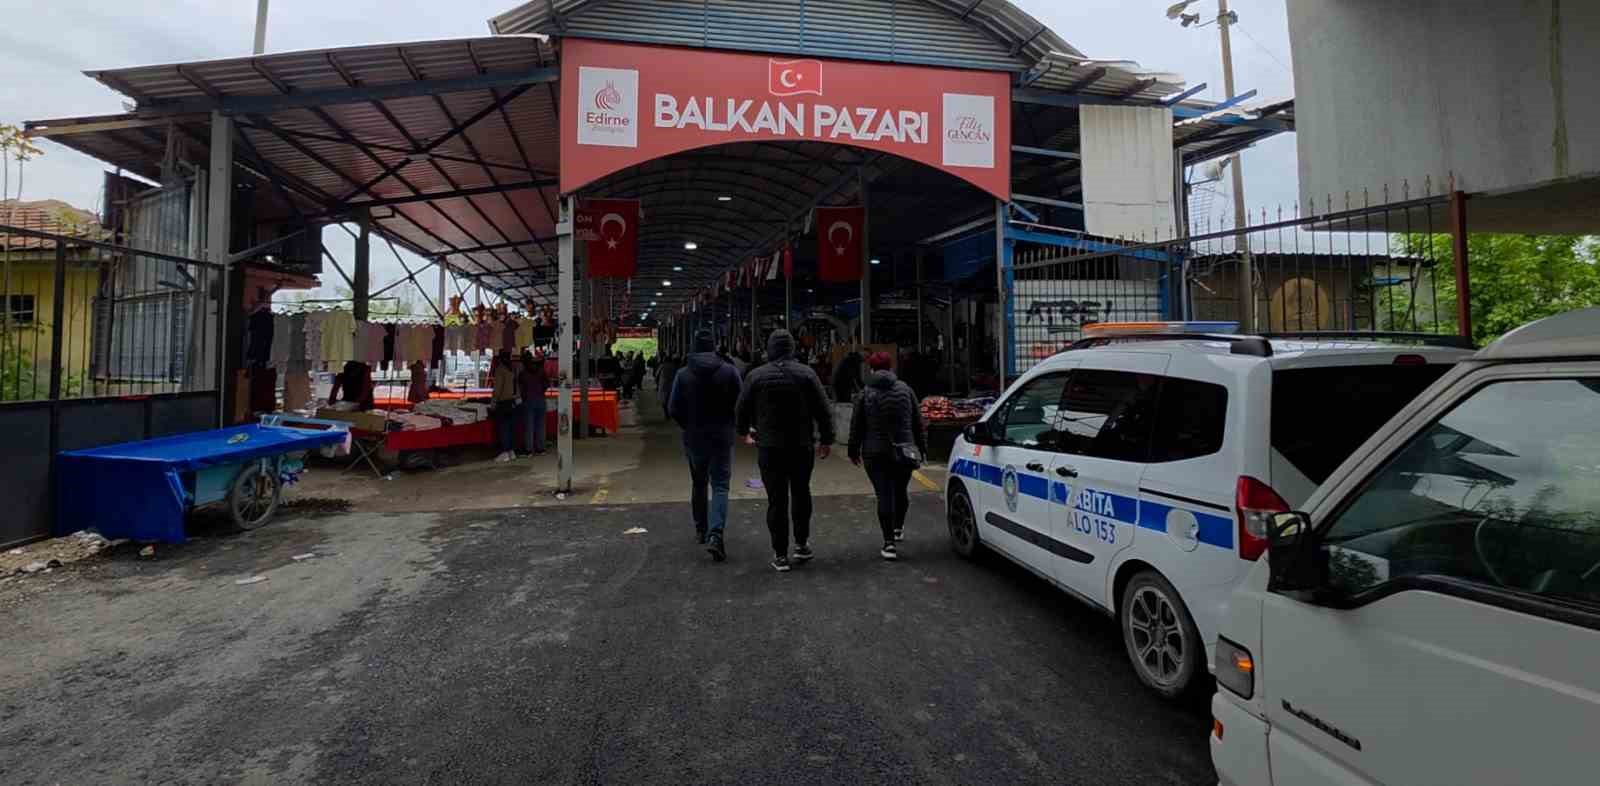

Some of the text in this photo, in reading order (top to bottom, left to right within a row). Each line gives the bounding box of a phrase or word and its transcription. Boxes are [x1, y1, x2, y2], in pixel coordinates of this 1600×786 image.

[586, 111, 630, 126] Edirne
[654, 93, 929, 144] BALKAN PAZARI
[1066, 511, 1117, 545] ALO 153
